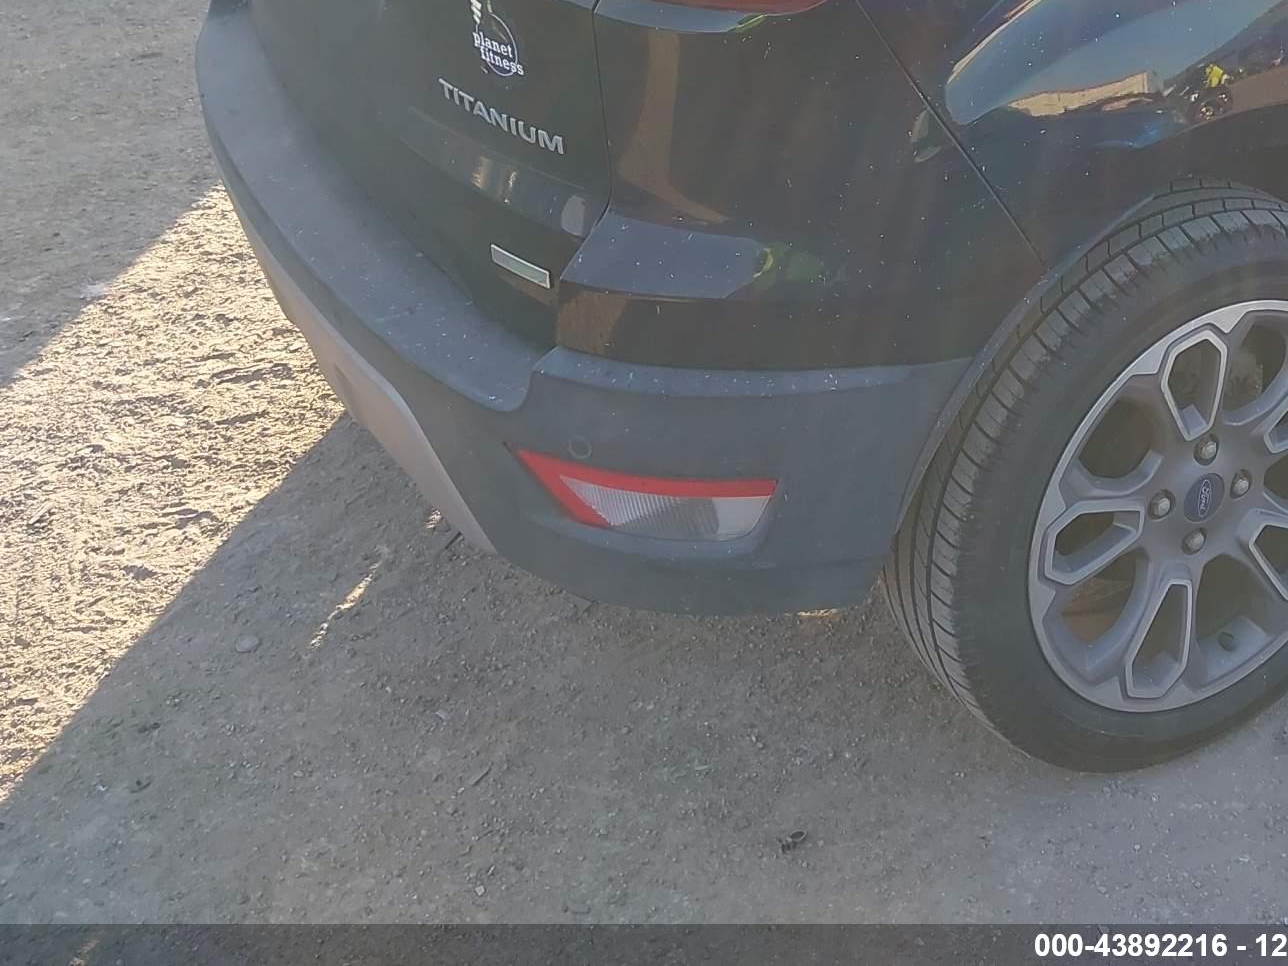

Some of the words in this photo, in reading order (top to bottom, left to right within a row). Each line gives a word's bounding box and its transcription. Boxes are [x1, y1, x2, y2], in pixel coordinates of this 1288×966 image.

[472, 31, 513, 59] planet
[480, 47, 525, 76] fitness
[438, 77, 564, 155] TITANIUM
